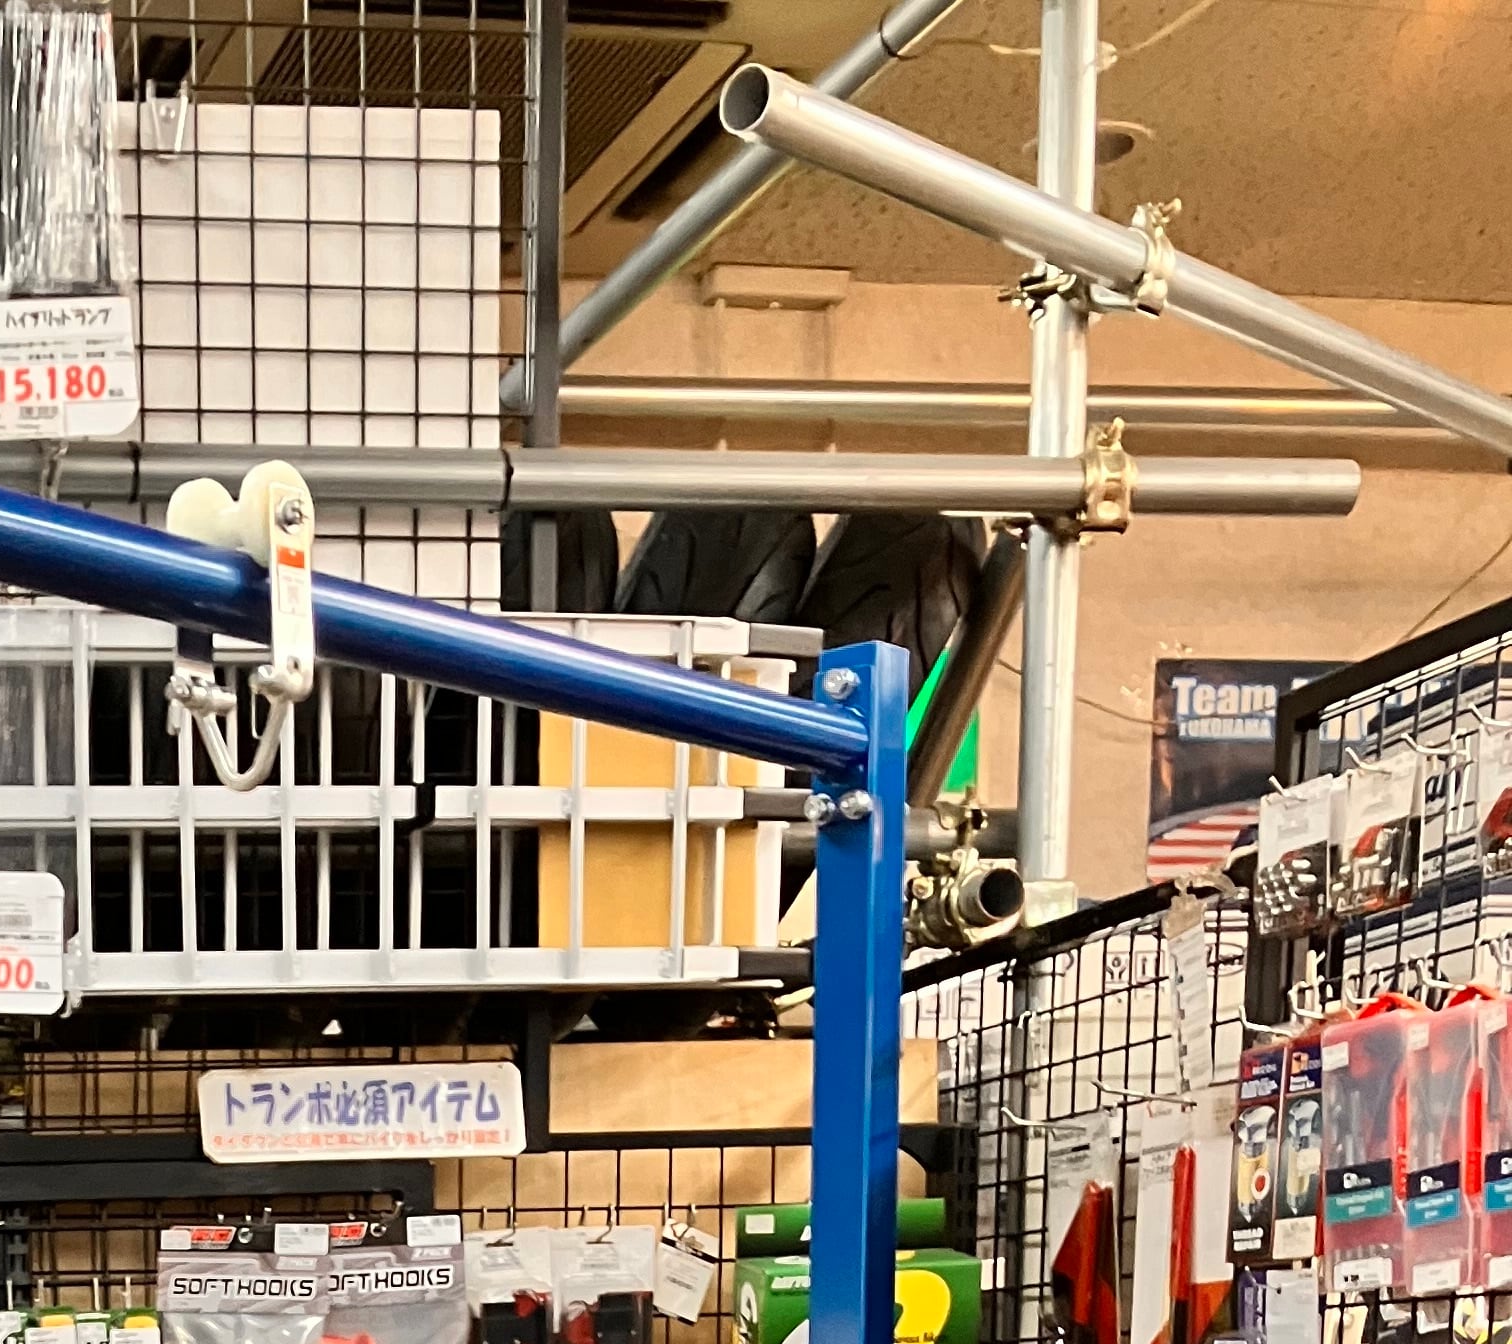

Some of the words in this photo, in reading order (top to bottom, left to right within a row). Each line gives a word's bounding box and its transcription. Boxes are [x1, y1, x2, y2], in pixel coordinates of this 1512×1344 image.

[1172, 677, 1277, 717] Team
[224, 1080, 501, 1125] トランポ必須アイテム
[173, 1277, 233, 1297] SOFT
[236, 1276, 315, 1298] HOOKS
[328, 1272, 371, 1293] OFT
[373, 1265, 452, 1290] HOOKS
